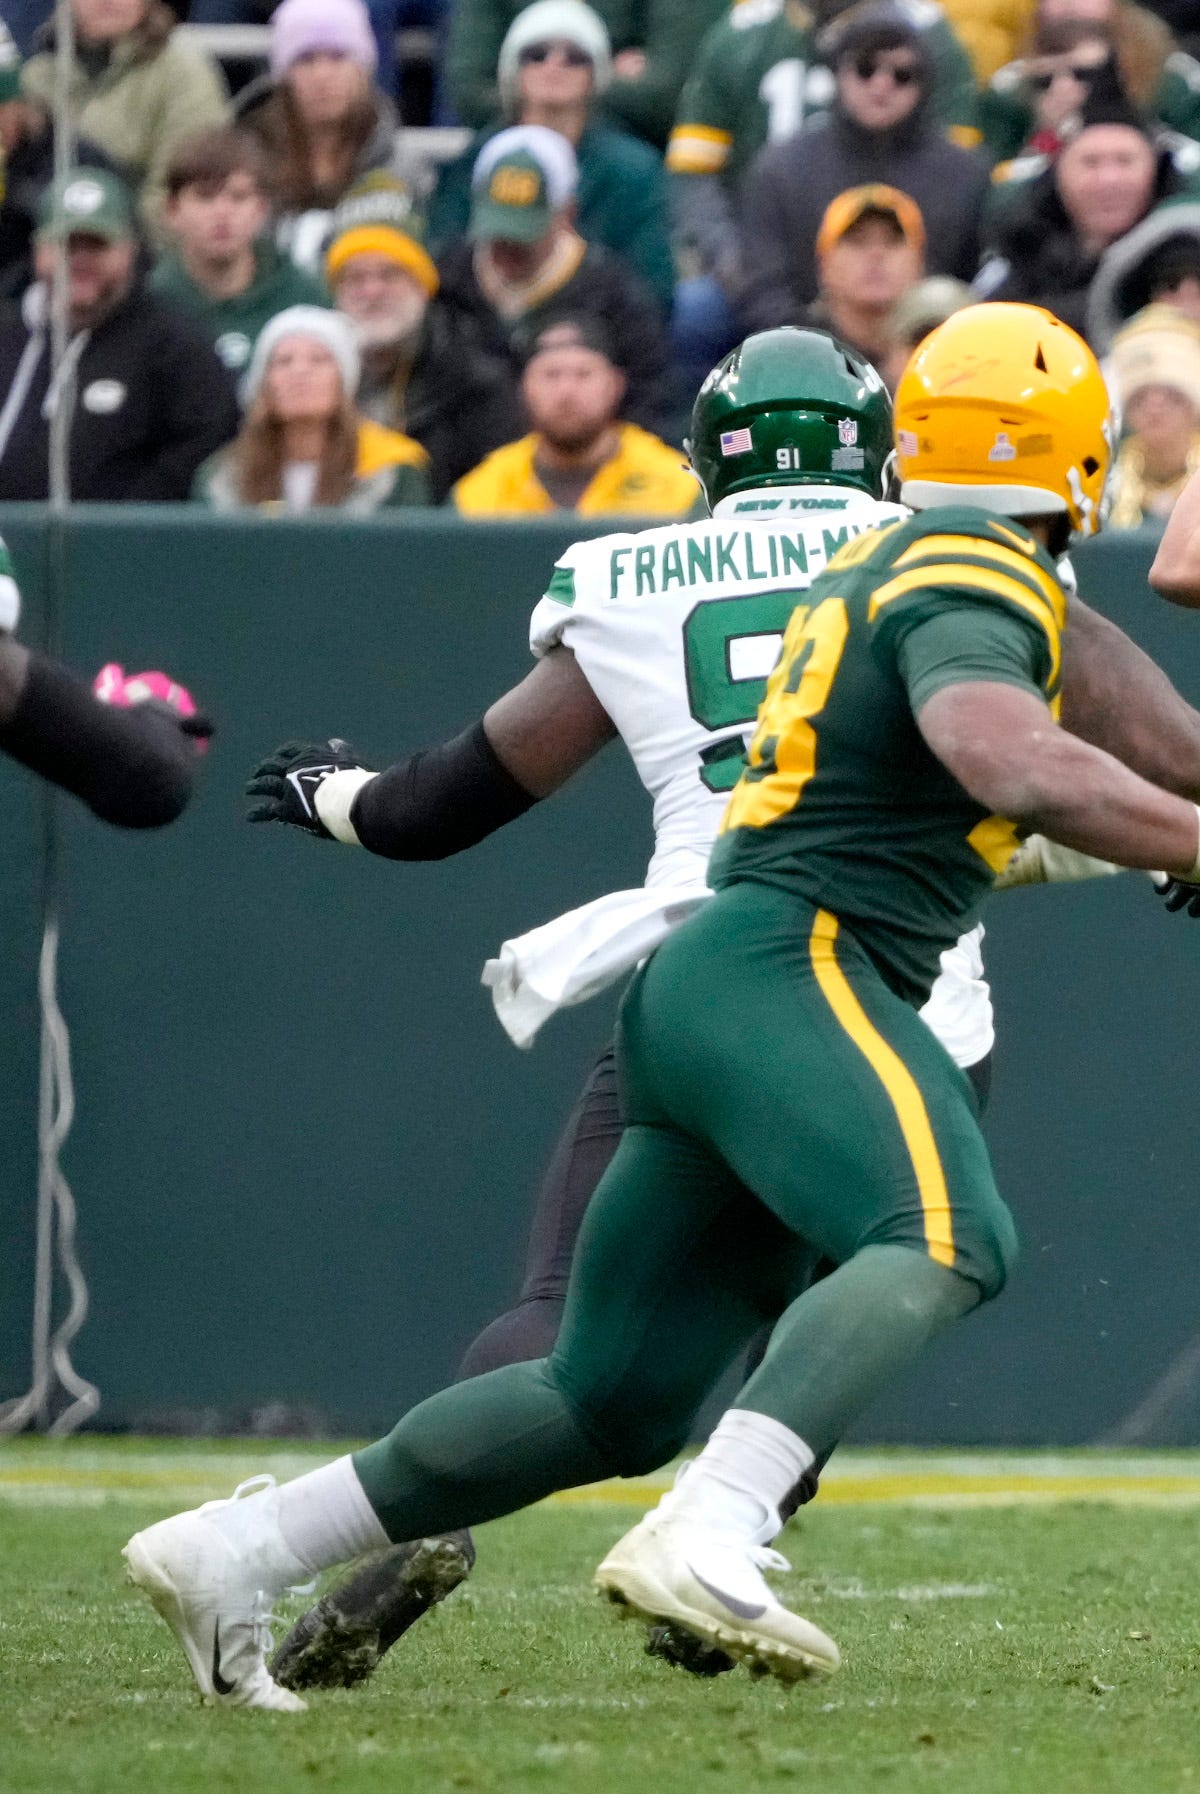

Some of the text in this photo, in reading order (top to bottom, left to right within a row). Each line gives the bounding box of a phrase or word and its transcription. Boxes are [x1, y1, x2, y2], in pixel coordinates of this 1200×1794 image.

[777, 448, 800, 470] 91
[735, 499, 850, 513] NEW YORK
[610, 515, 901, 600] FRANKLIN-M
[718, 598, 849, 836] 8
